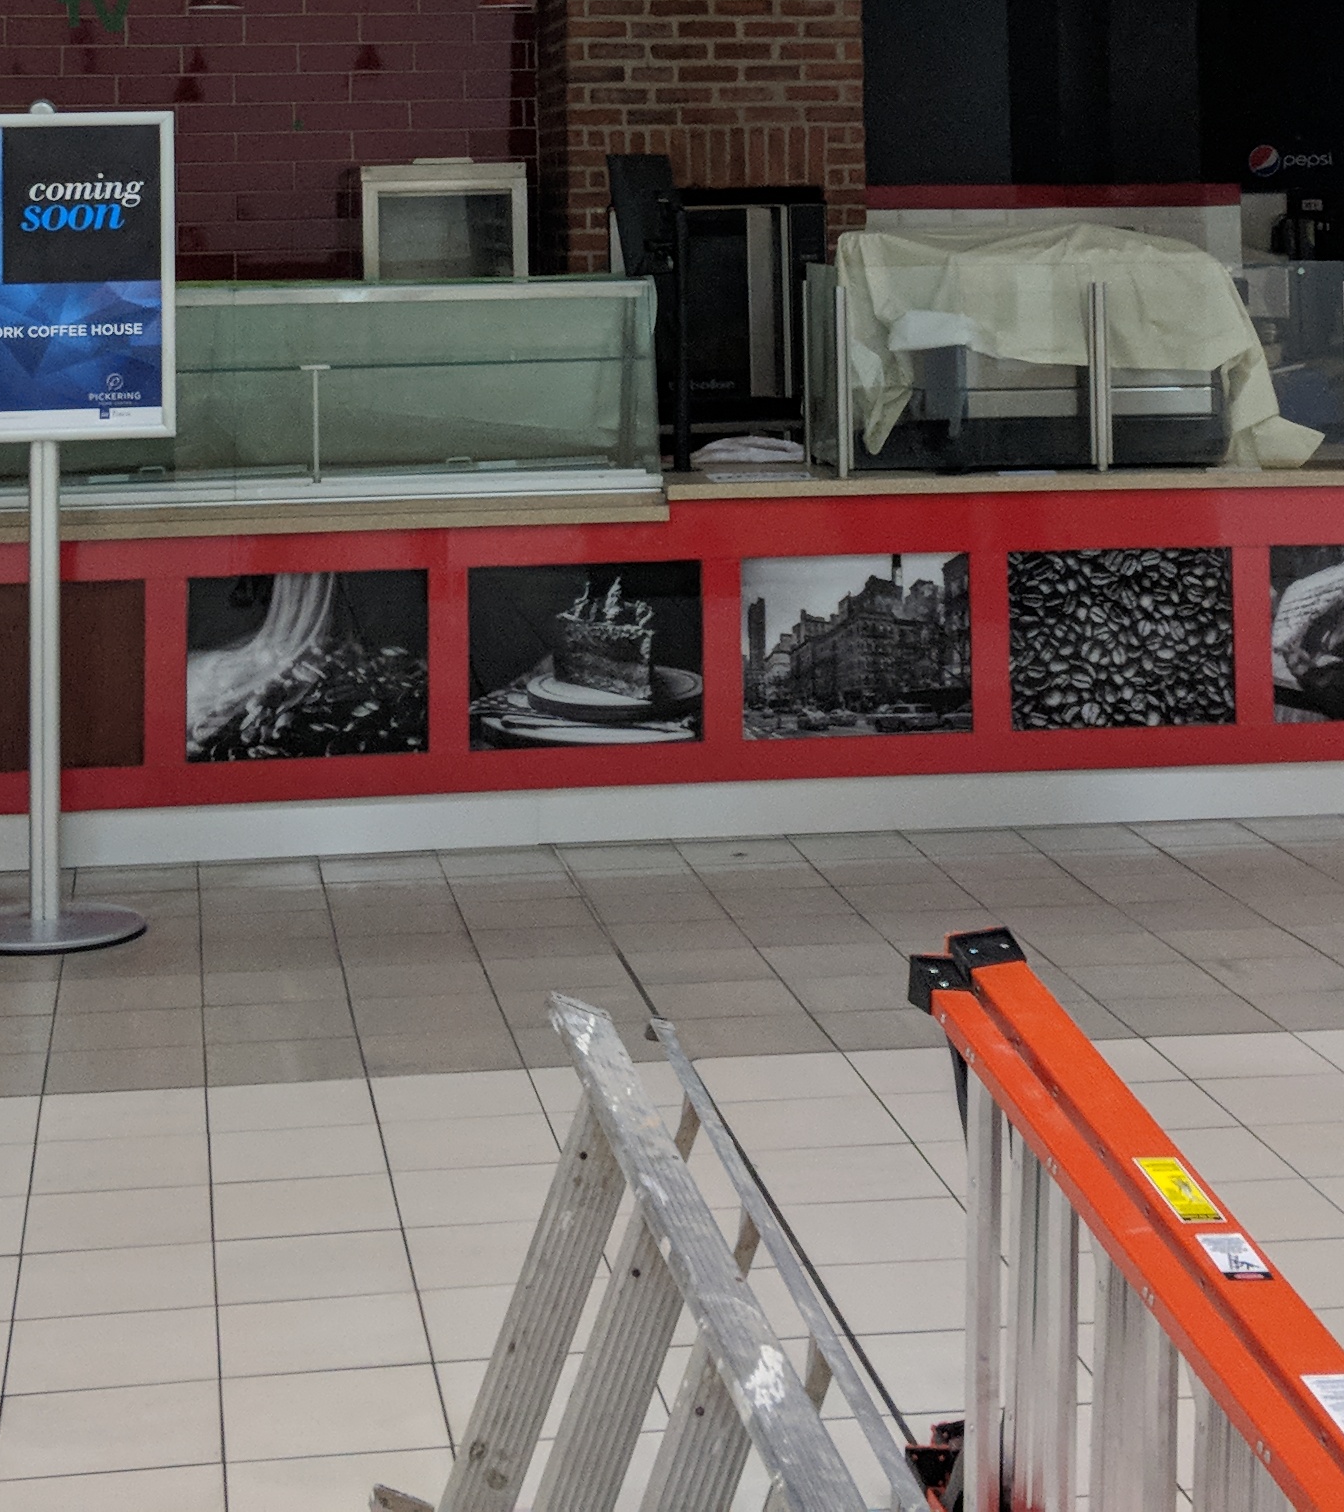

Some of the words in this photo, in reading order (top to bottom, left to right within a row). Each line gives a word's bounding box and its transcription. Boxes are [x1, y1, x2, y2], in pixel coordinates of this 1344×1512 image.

[1283, 151, 1333, 168] pepsi
[28, 172, 144, 207] coming
[20, 202, 125, 232] soon
[27, 324, 87, 338] COFFEE
[91, 322, 143, 336] HOUSE
[88, 391, 142, 401] PICKERING
